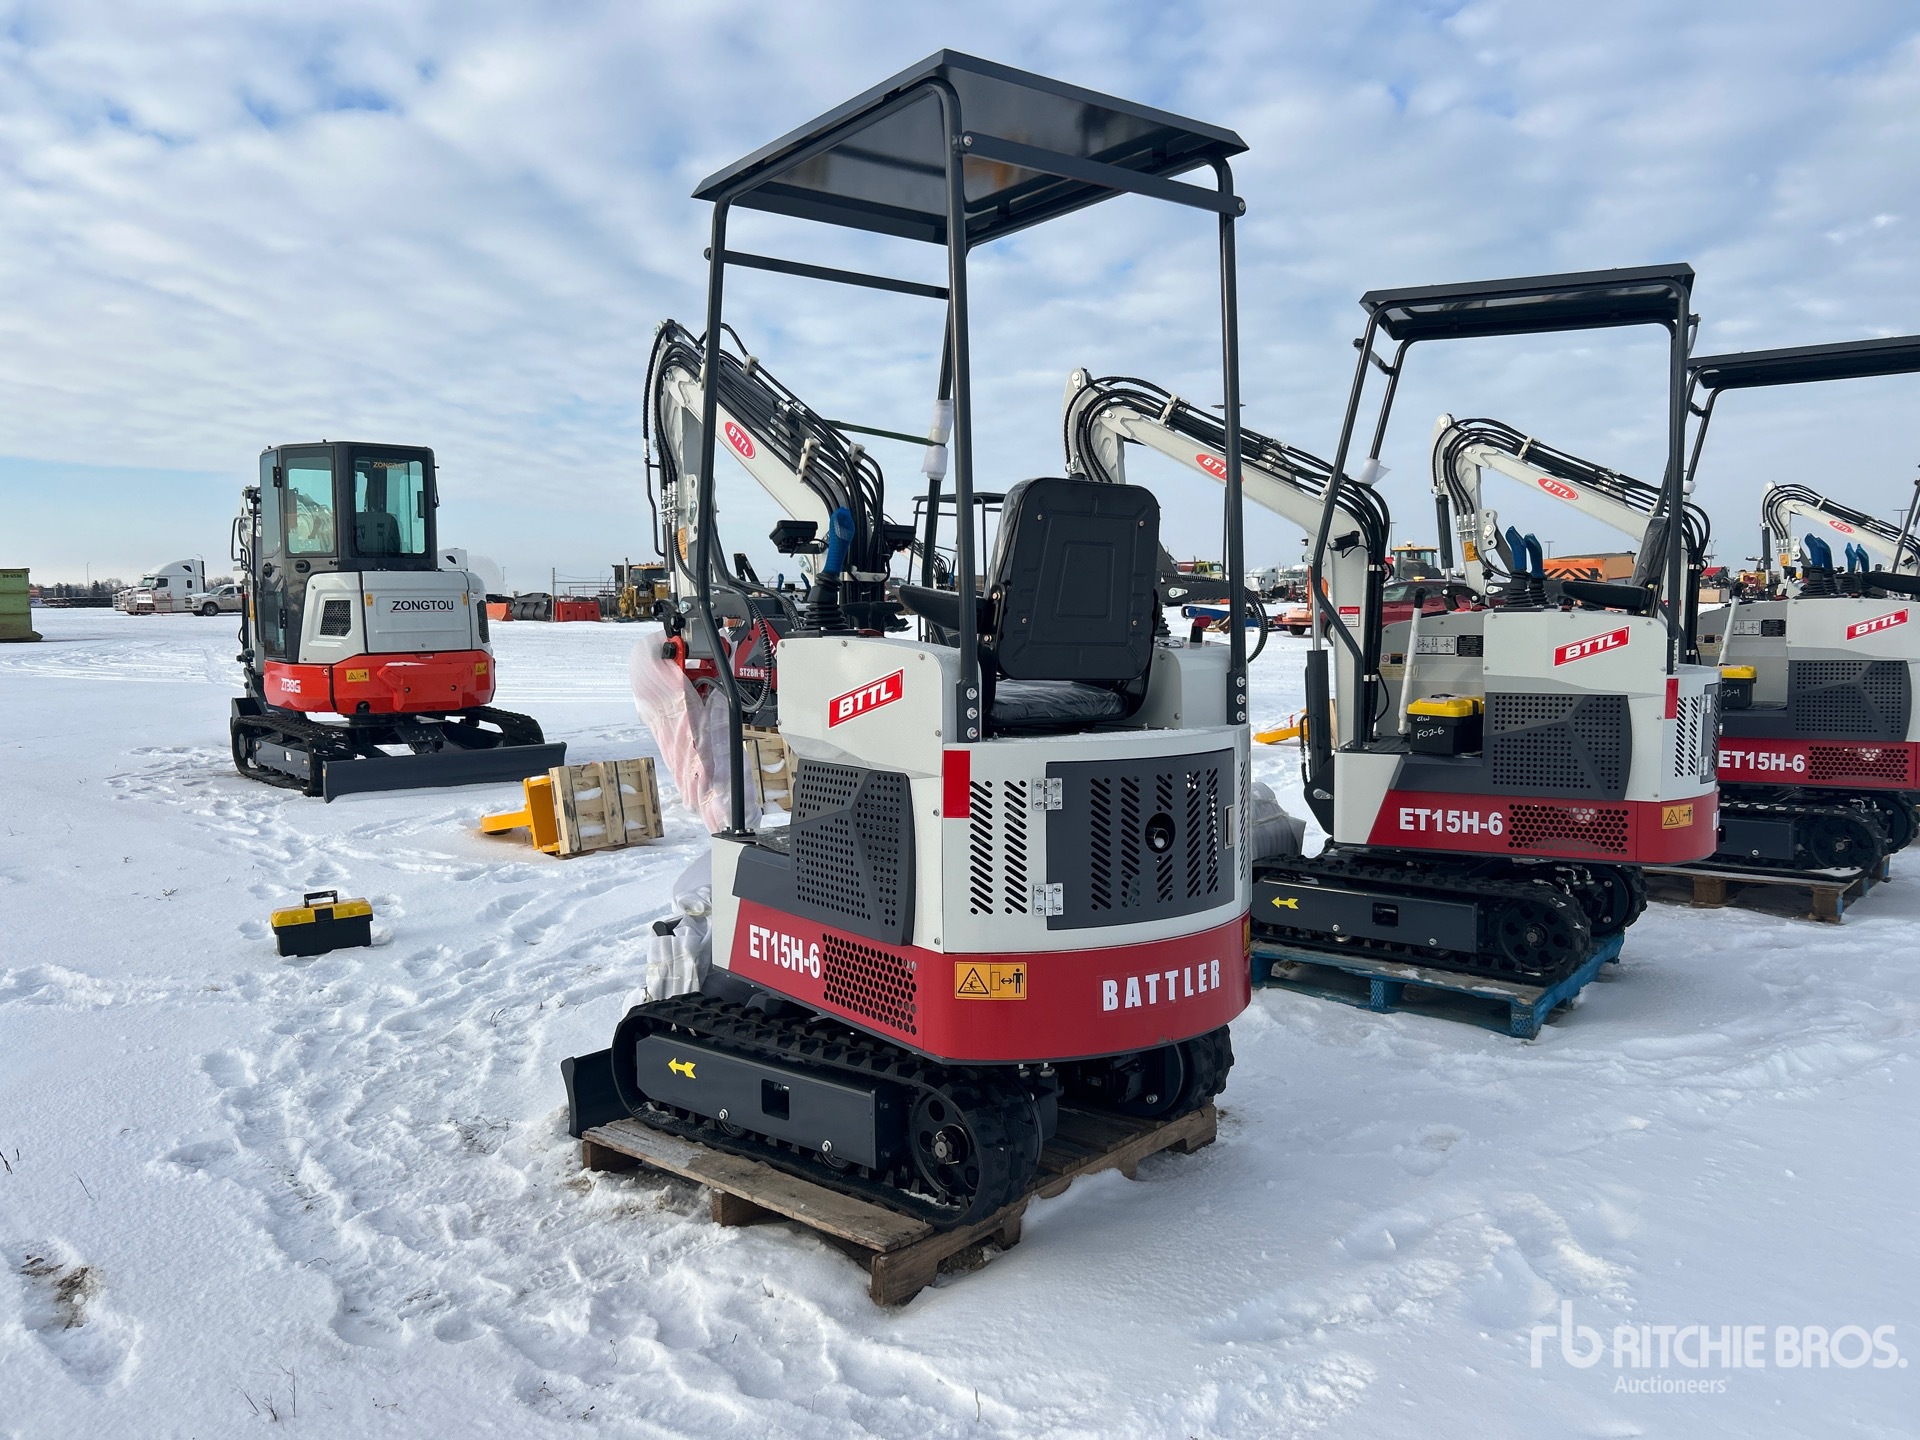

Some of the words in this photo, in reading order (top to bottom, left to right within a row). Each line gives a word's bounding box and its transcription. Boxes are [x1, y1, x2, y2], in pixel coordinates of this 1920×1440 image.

[729, 426, 748, 455] BTTL
[1203, 457, 1227, 479] BTT
[1544, 481, 1569, 498] BTTL
[392, 601, 454, 611] ZONGTOU
[1855, 614, 1901, 635] BTTL
[1565, 634, 1620, 660] BTTL
[839, 681, 894, 719] BTTL
[1718, 750, 1805, 773] ET15H-6
[1399, 807, 1504, 836] ET15H-6
[749, 924, 821, 979] ET15H-6
[1102, 959, 1220, 1012] BATTLER
